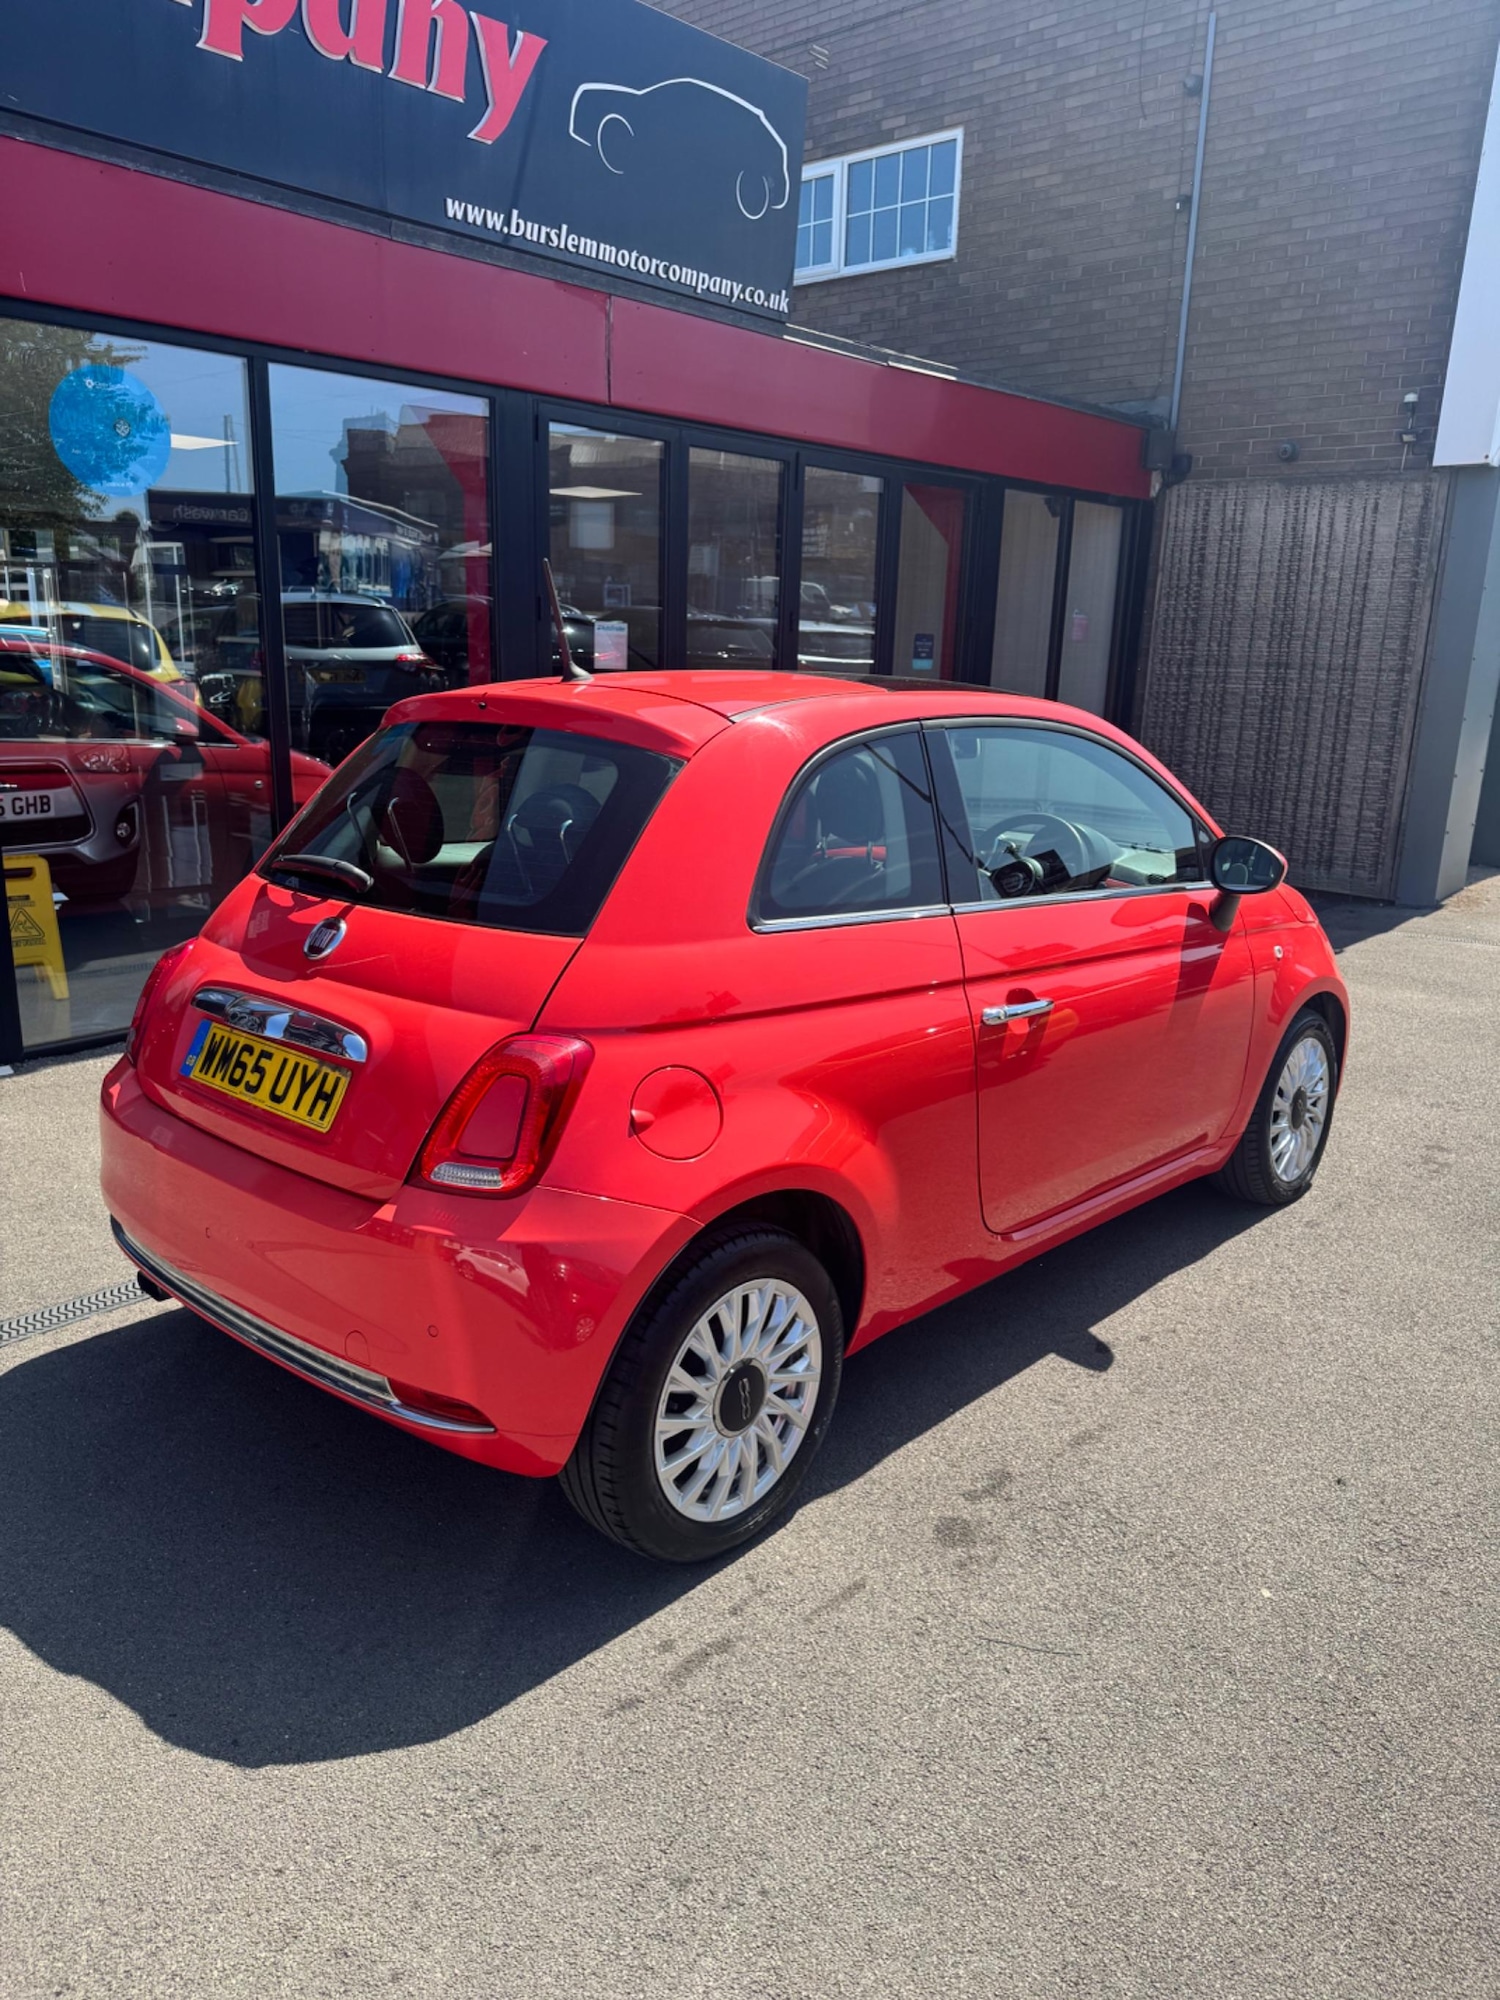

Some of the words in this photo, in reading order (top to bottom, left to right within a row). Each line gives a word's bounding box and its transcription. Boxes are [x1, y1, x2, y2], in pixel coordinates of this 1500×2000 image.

[172, 0, 549, 144] pany
[445, 197, 789, 314] www.burslemmotorcompany.co.uk
[11, 794, 52, 816] GHB
[198, 1032, 274, 1095] WM65
[268, 1057, 342, 1122] UYH
